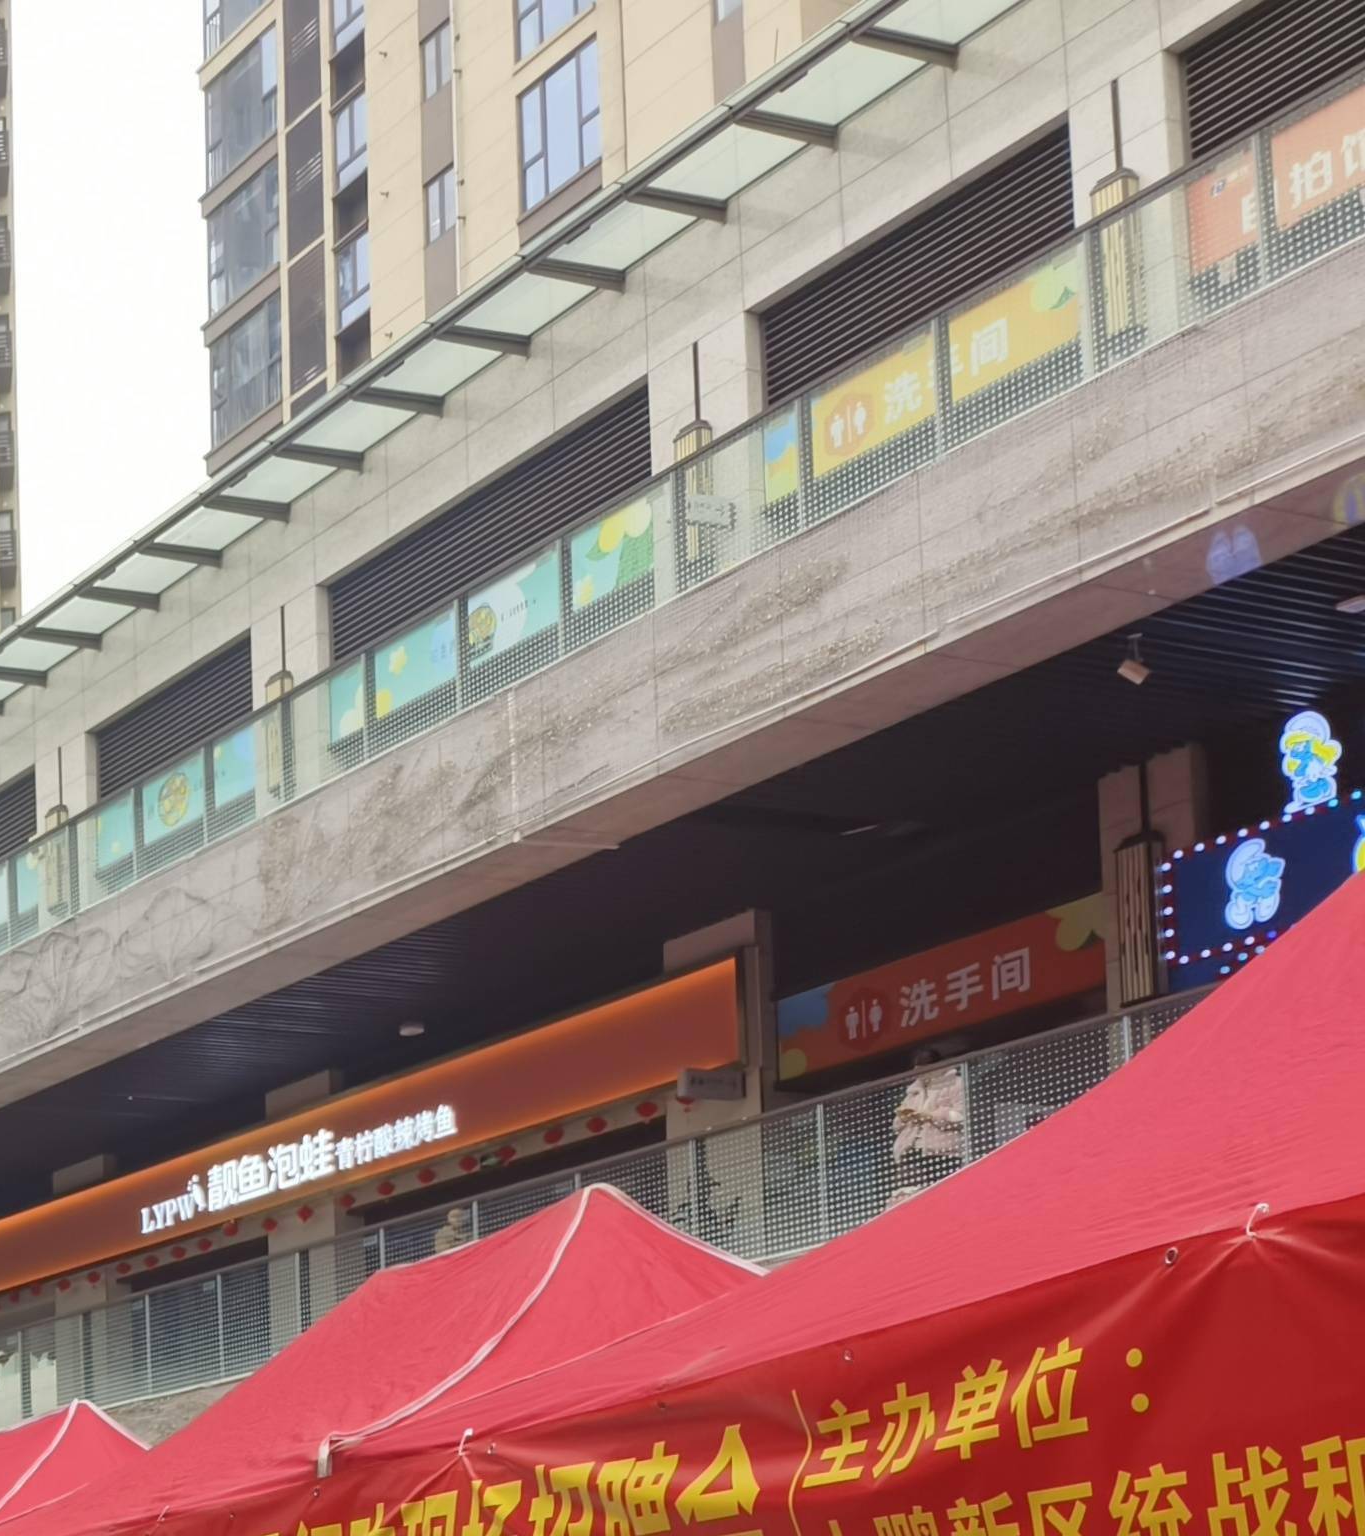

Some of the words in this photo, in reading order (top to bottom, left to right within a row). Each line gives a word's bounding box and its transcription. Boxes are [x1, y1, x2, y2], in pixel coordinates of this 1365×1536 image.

[898, 946, 1031, 1028] 洗手间
[206, 1127, 337, 1213] 靓鱼泡蛙
[802, 1337, 1151, 1490] 主办单位：
